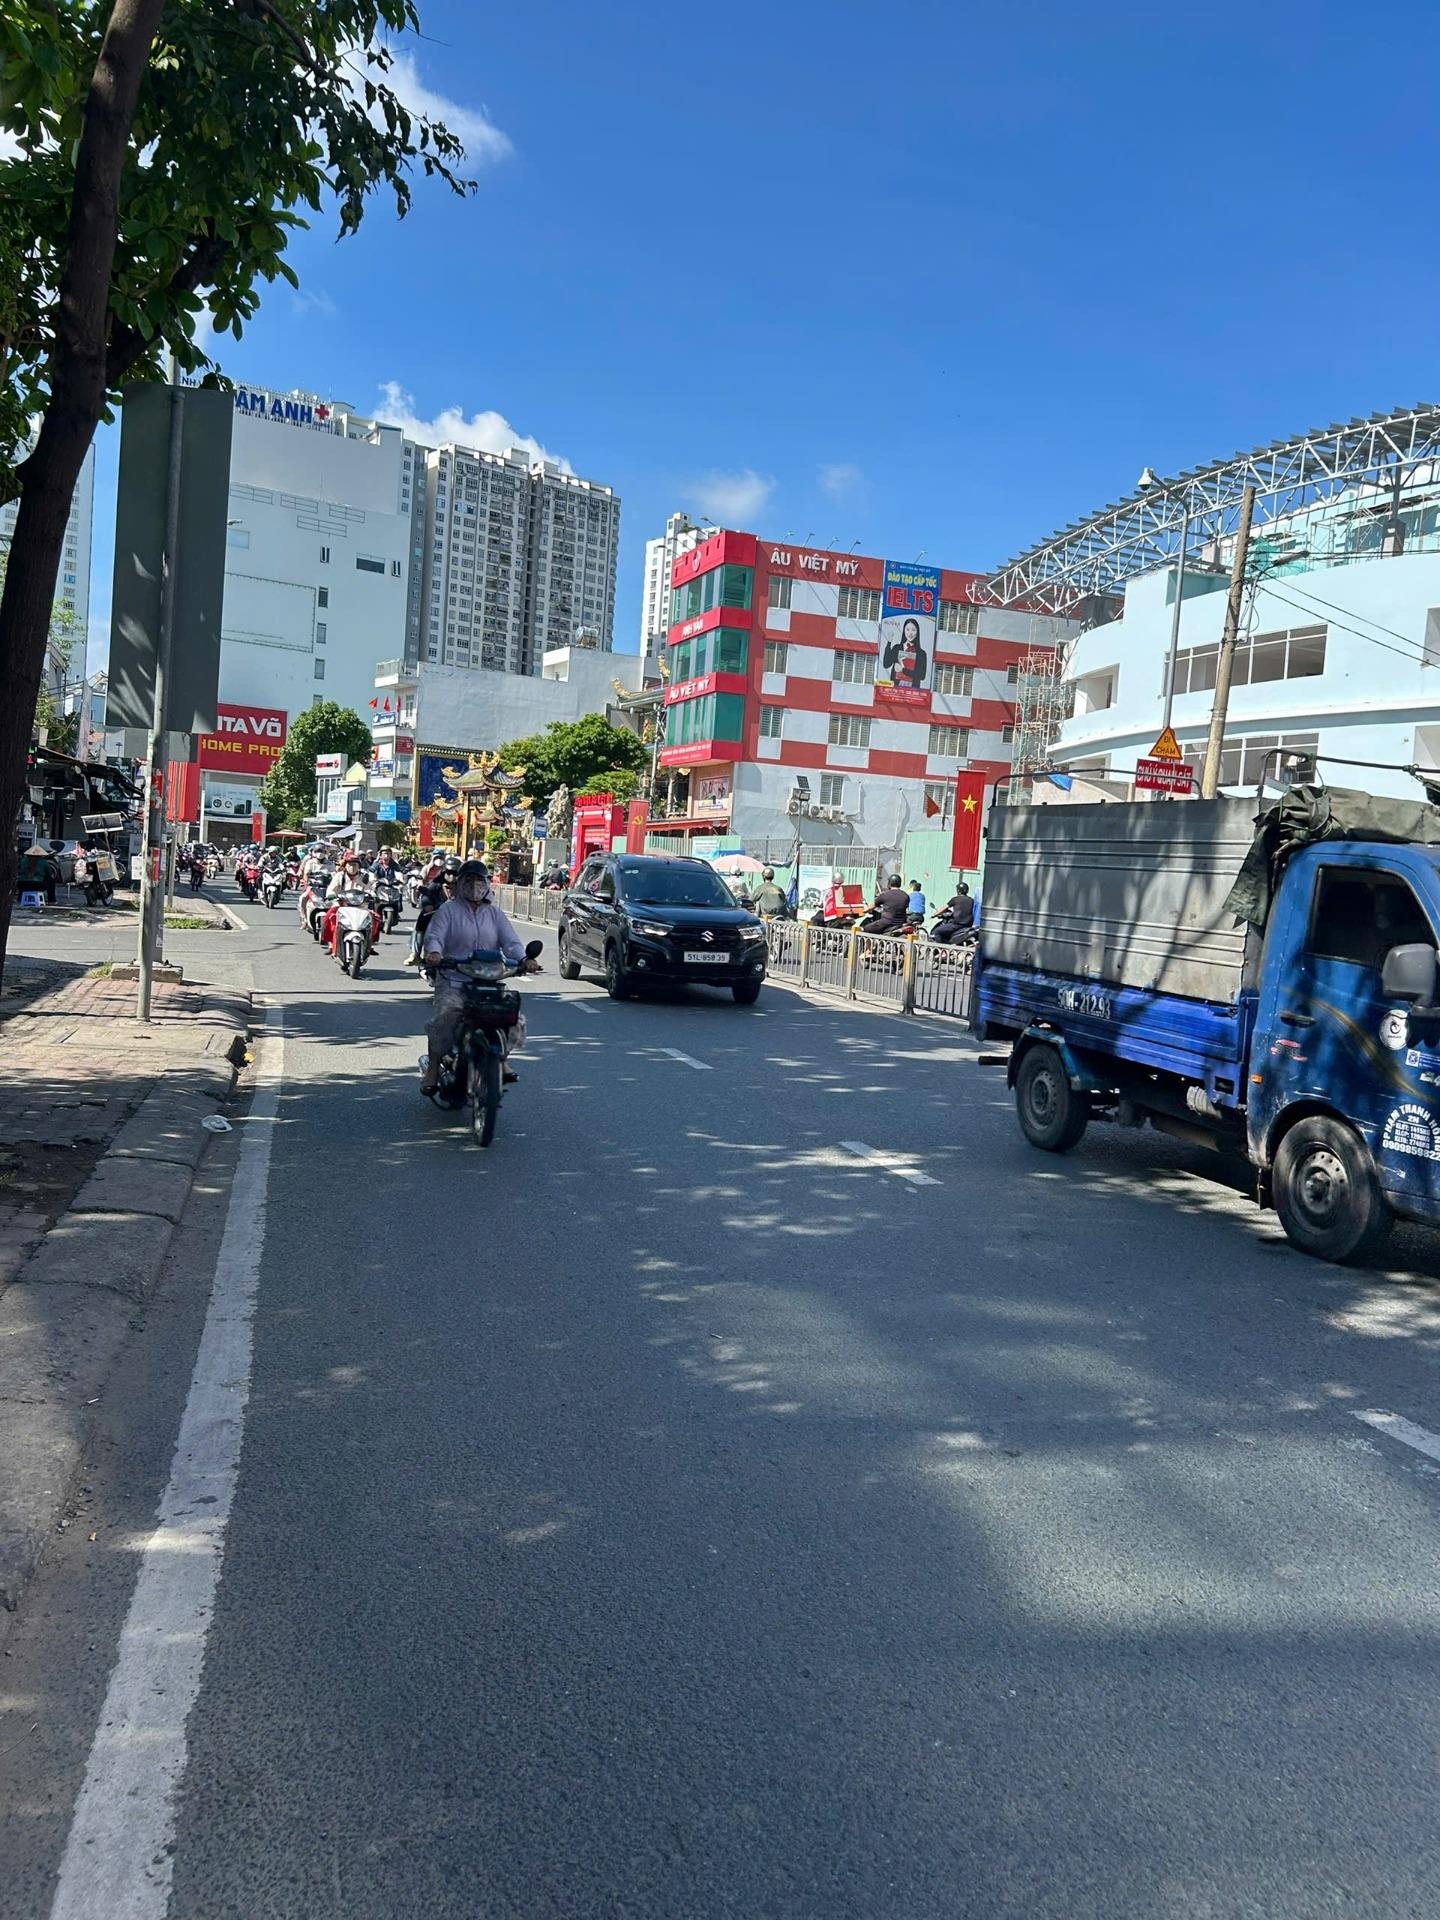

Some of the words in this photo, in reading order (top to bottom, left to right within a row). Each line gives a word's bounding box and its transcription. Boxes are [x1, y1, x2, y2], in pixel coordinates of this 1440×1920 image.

[233, 386, 266, 413] ÂM
[270, 397, 313, 424] ANH
[770, 547, 791, 566] ÂU
[798, 553, 829, 573] VIỆT
[836, 559, 859, 576] MỸ
[886, 585, 934, 613] IELTS
[217, 715, 248, 734] ITA
[249, 716, 282, 738] VÕ
[248, 743, 283, 757] PRO
[1399, 1103, 1431, 1121] THANH
